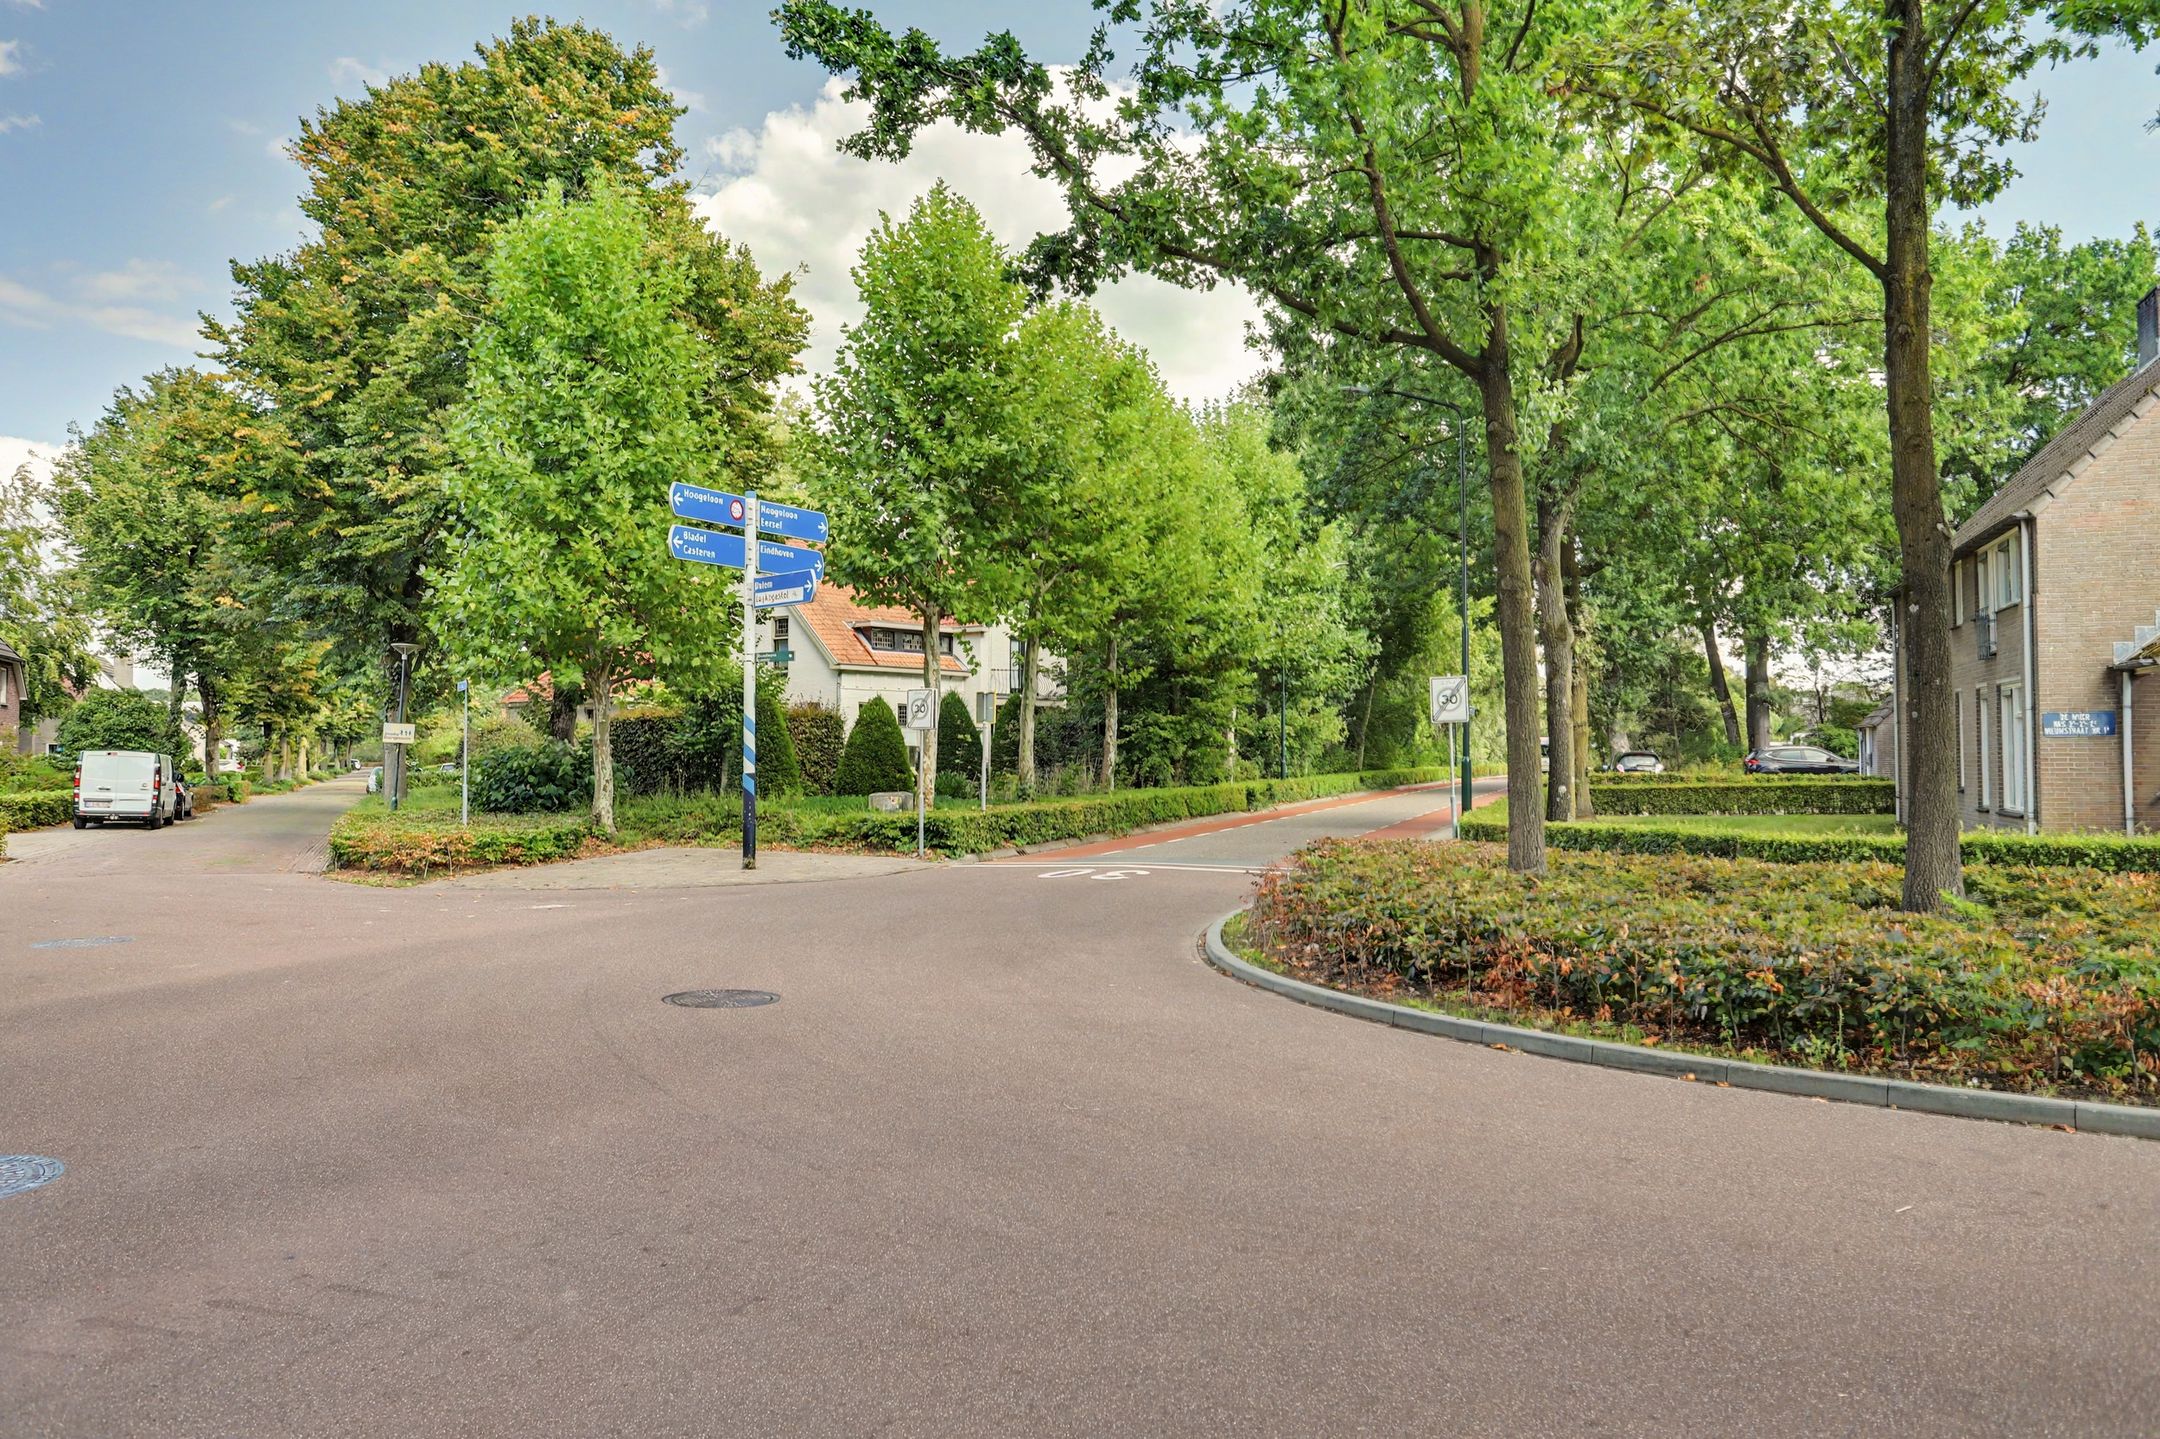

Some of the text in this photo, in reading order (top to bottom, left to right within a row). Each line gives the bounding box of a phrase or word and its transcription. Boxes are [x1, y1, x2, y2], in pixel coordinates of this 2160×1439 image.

[684, 488, 723, 504] Hoogeloon
[760, 504, 799, 520] Hoogeloon
[760, 517, 783, 530] Eersel
[683, 530, 707, 543] Bladel
[683, 544, 716, 559] Casteren
[760, 544, 795, 559] Eindhoven
[1441, 694, 1458, 705] 30
[914, 703, 926, 714] 30
